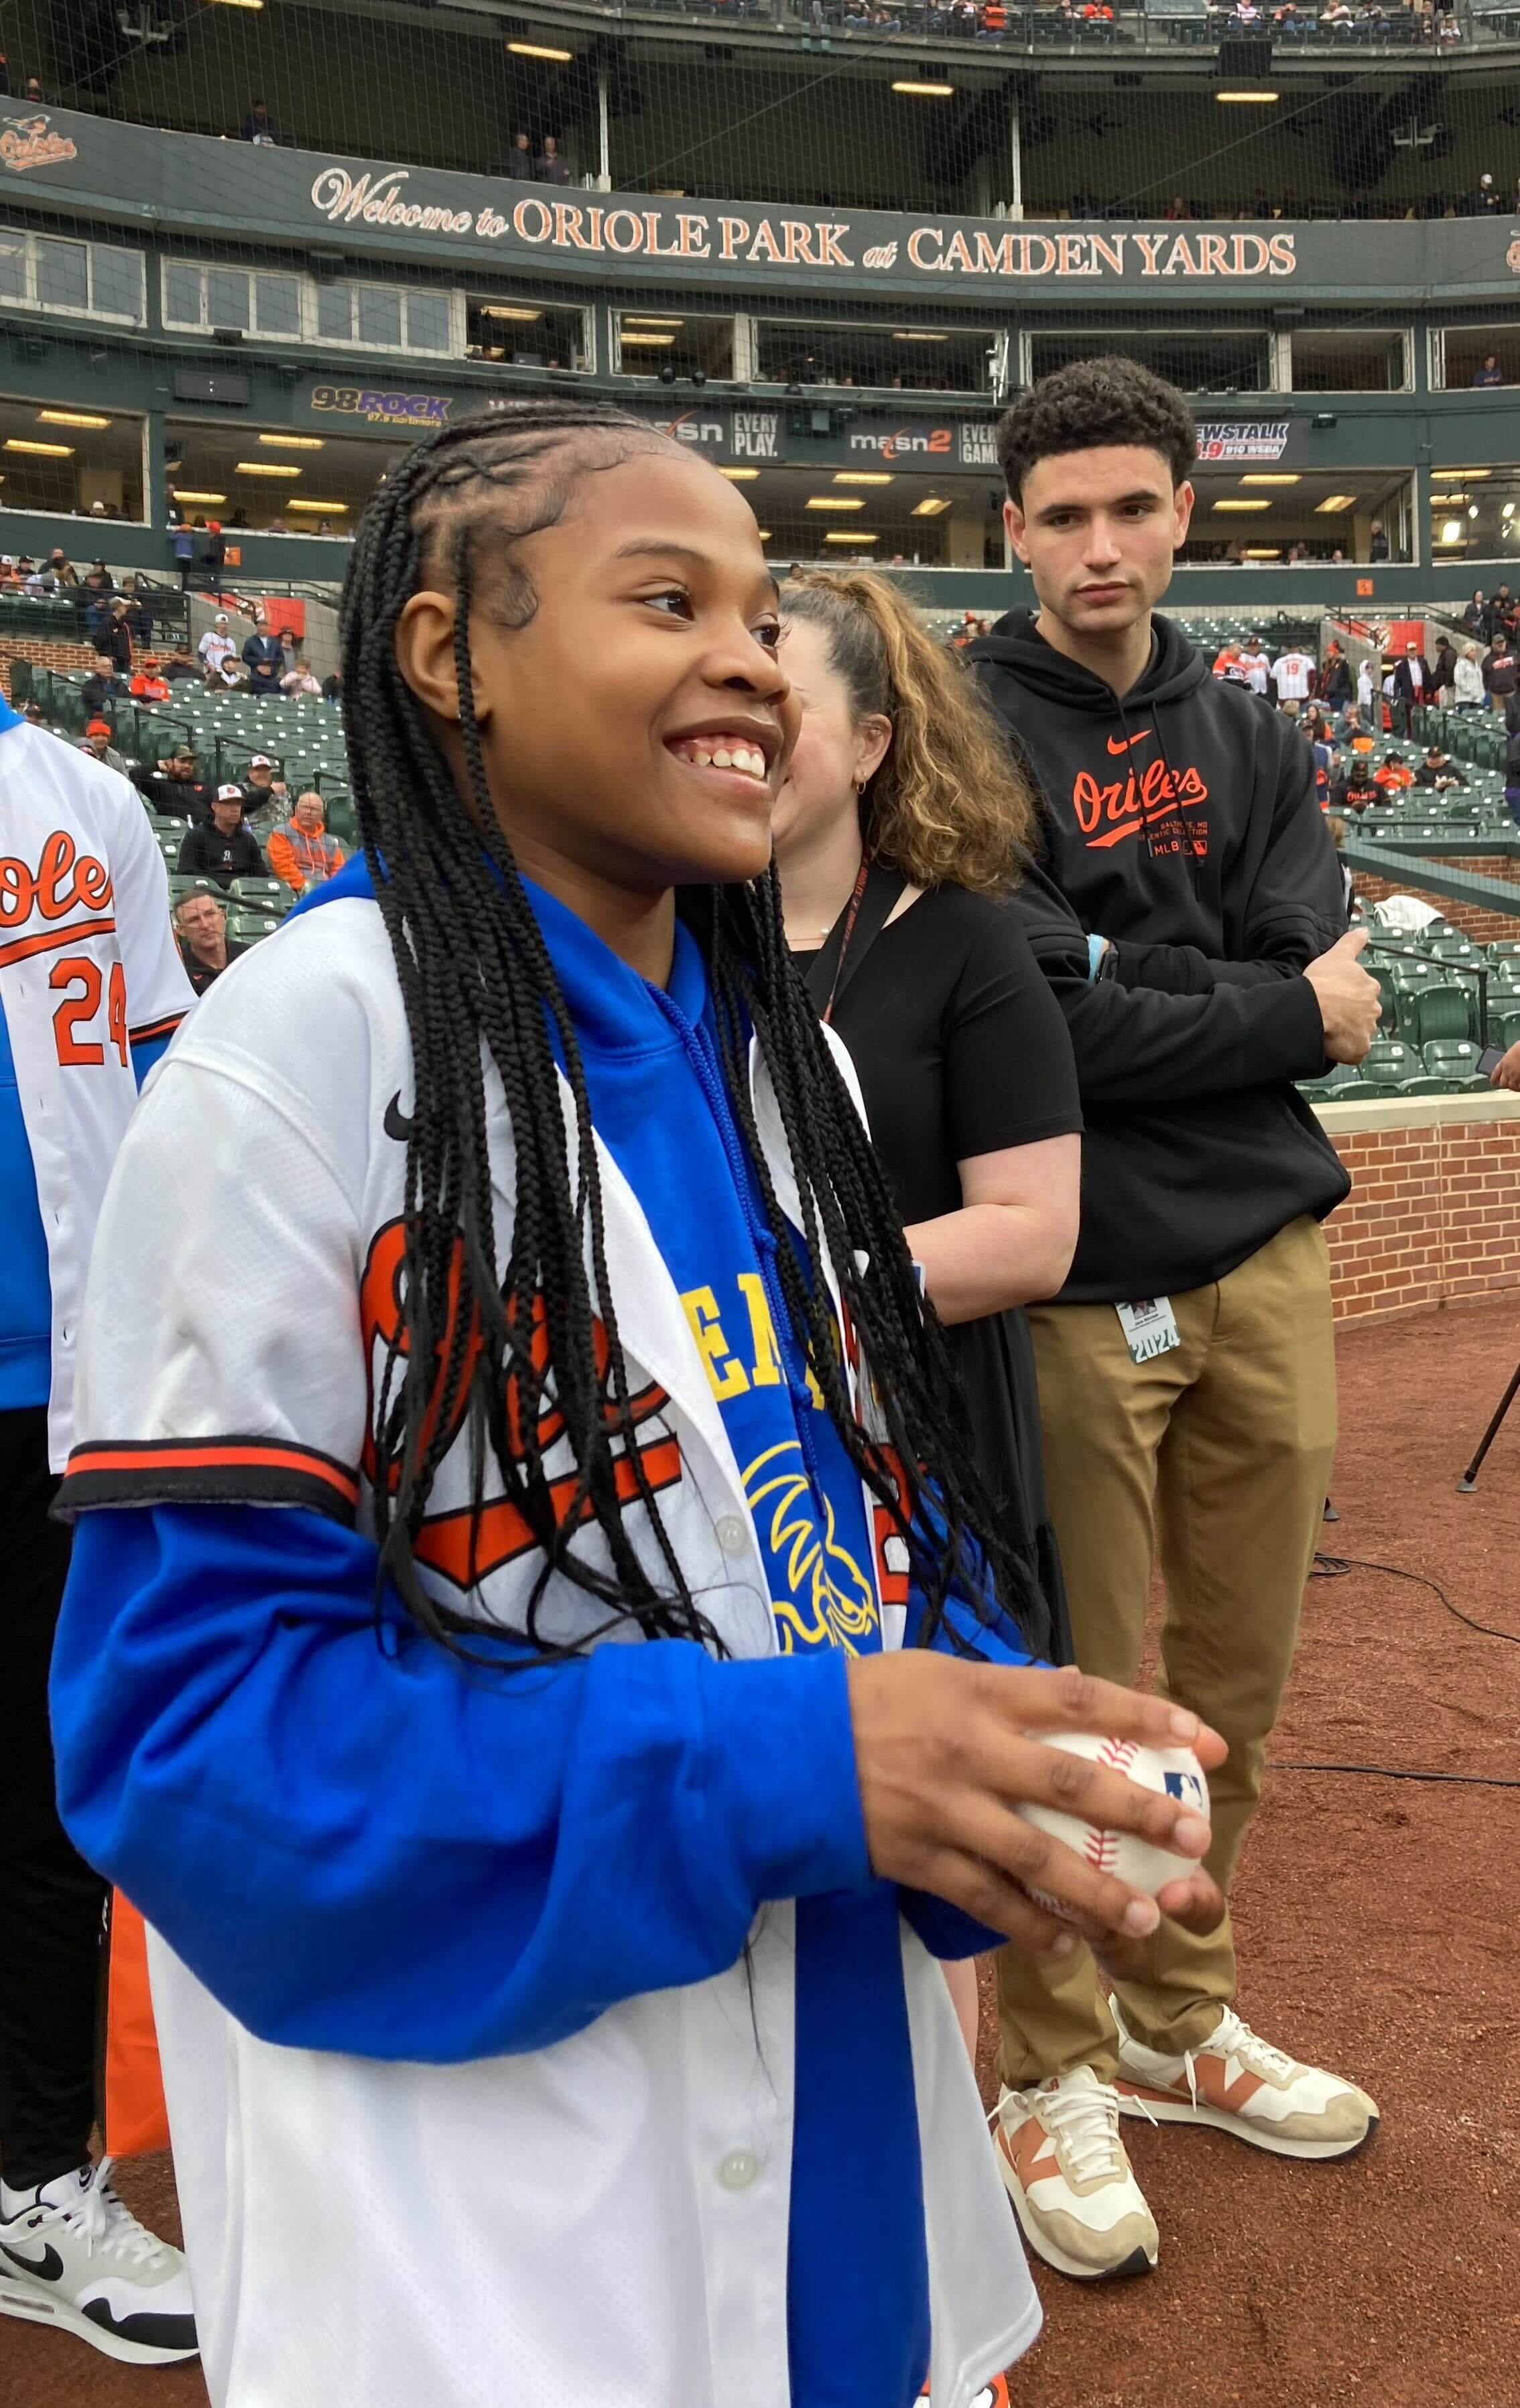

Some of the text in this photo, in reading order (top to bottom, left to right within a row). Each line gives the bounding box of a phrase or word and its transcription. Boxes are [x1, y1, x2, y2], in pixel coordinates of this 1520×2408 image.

[311, 168, 1297, 275] Welcome to ORIOLE PARK at CAMDEN YARDS
[735, 412, 779, 434] EVERY
[962, 424, 1000, 443] EVER
[1196, 423, 1289, 440] EWSTALK
[735, 432, 779, 457] PLAY.
[1154, 840, 1180, 856] MLB
[1129, 1326, 1181, 1363] 2024
